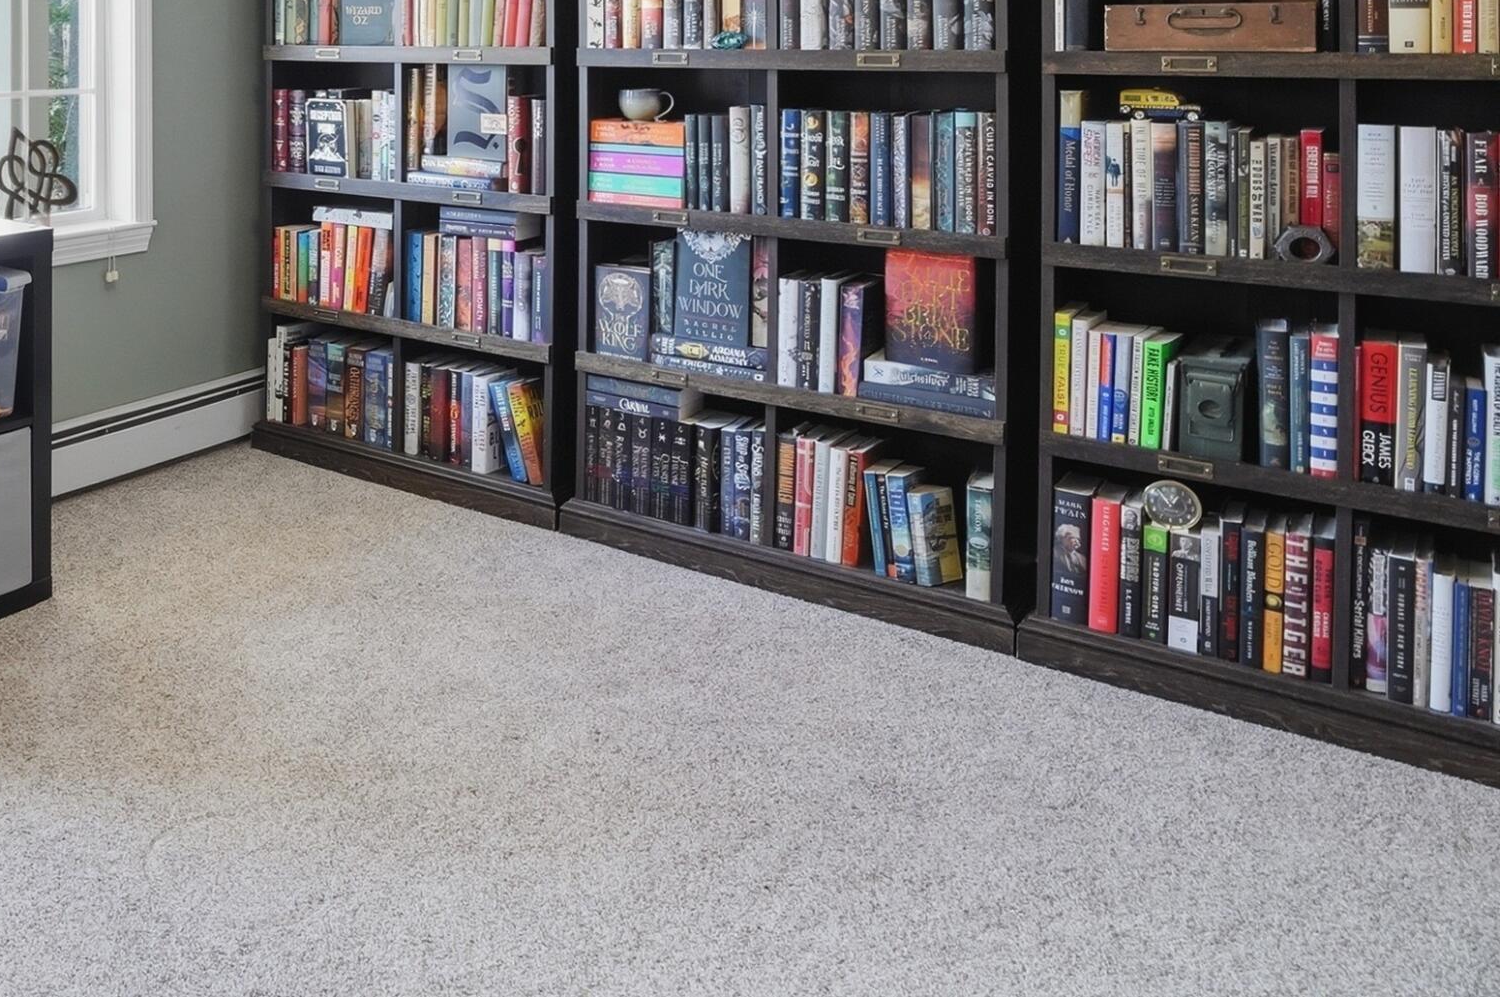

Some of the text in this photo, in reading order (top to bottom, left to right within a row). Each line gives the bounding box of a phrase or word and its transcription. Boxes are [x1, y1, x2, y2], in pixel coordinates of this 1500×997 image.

[986, 126, 994, 152] CURSE
[1136, 147, 1147, 165] TIME
[1474, 139, 1487, 173] FEAR
[986, 155, 994, 188] CARVED
[1064, 140, 1076, 213] Medal of Honor
[1136, 169, 1146, 178] OF
[986, 191, 994, 199] IN
[1136, 182, 1147, 199] WAR
[1268, 182, 1278, 207] AFRAID
[1305, 185, 1318, 199] KILL
[986, 204, 994, 225] BONE
[1190, 196, 1199, 242] SAM KEAN
[1252, 203, 1263, 223] WAR
[1442, 171, 1451, 261] HISTORY UNITED STATES
[1451, 188, 1459, 230] INDIGENOUS
[1475, 193, 1489, 279] BOB WOODWARD
[693, 262, 727, 284] ONE
[689, 280, 730, 301] DARK
[678, 295, 743, 320] WINDOW
[599, 318, 643, 338] WOLF
[686, 328, 734, 341] GILLIG
[892, 322, 970, 352] STONE
[602, 332, 637, 354] KING
[896, 370, 950, 388] Quicksilver
[1057, 343, 1067, 405] TRUE FALSE
[1145, 347, 1160, 403] FAKE HISTORY
[1369, 353, 1390, 415] GENIUS
[1405, 367, 1418, 470] LEARNING FROM LEONARDO
[735, 435, 749, 456] SHIP
[1378, 433, 1393, 470] JAMES
[670, 454, 680, 486] THRONE
[679, 460, 690, 485] FATED
[751, 444, 765, 477] SIRENS
[733, 462, 750, 491] SPELLS
[778, 477, 794, 504] MAILER
[1058, 498, 1083, 510] MARK
[1054, 505, 1088, 520] TWAIN
[1245, 539, 1257, 603] Brilliant Blunders
[1266, 542, 1282, 589] GOLD
[1355, 555, 1363, 591] ENCYCLOPEDIA
[1051, 583, 1084, 597] CHERNOW
[1060, 577, 1075, 586] RON
[1174, 562, 1185, 612] OPPENHEIMER
[1282, 539, 1309, 677] THE TIGER
[1397, 593, 1405, 620] HUMANS
[1352, 599, 1365, 659] Serial Killers
[1397, 623, 1404, 631] OF
[1477, 638, 1492, 671] KNOT
